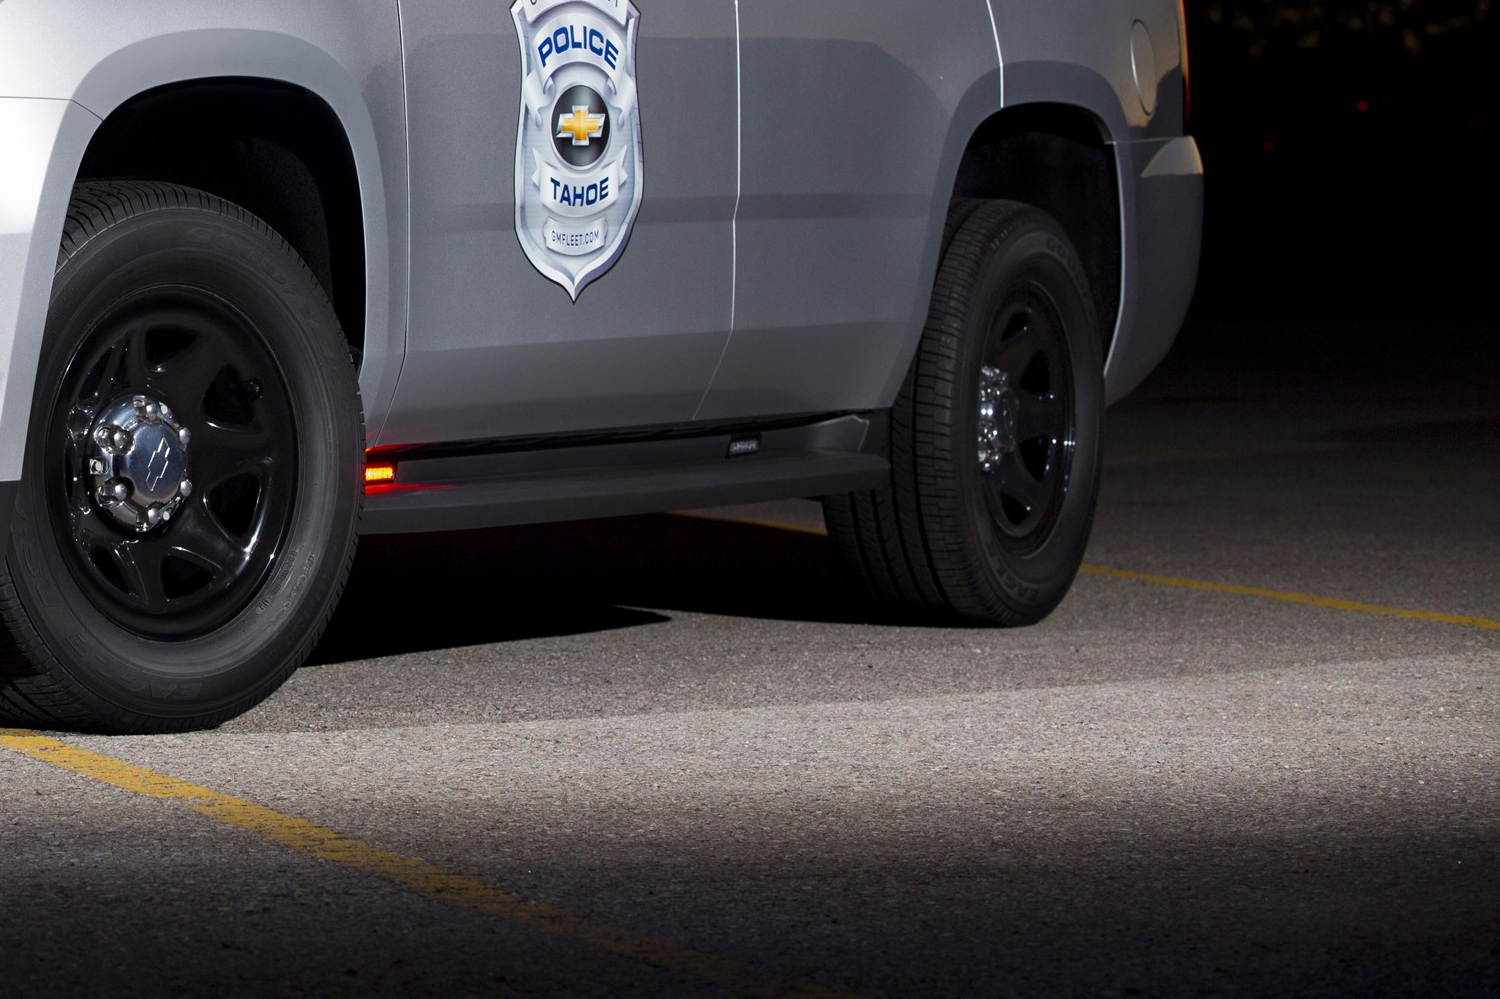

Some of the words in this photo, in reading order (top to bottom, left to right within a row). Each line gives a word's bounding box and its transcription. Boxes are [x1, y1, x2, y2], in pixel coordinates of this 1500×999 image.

[538, 25, 619, 70] POLICE
[550, 177, 609, 207] TAHOE
[551, 229, 600, 247] GMFLEET.COM
